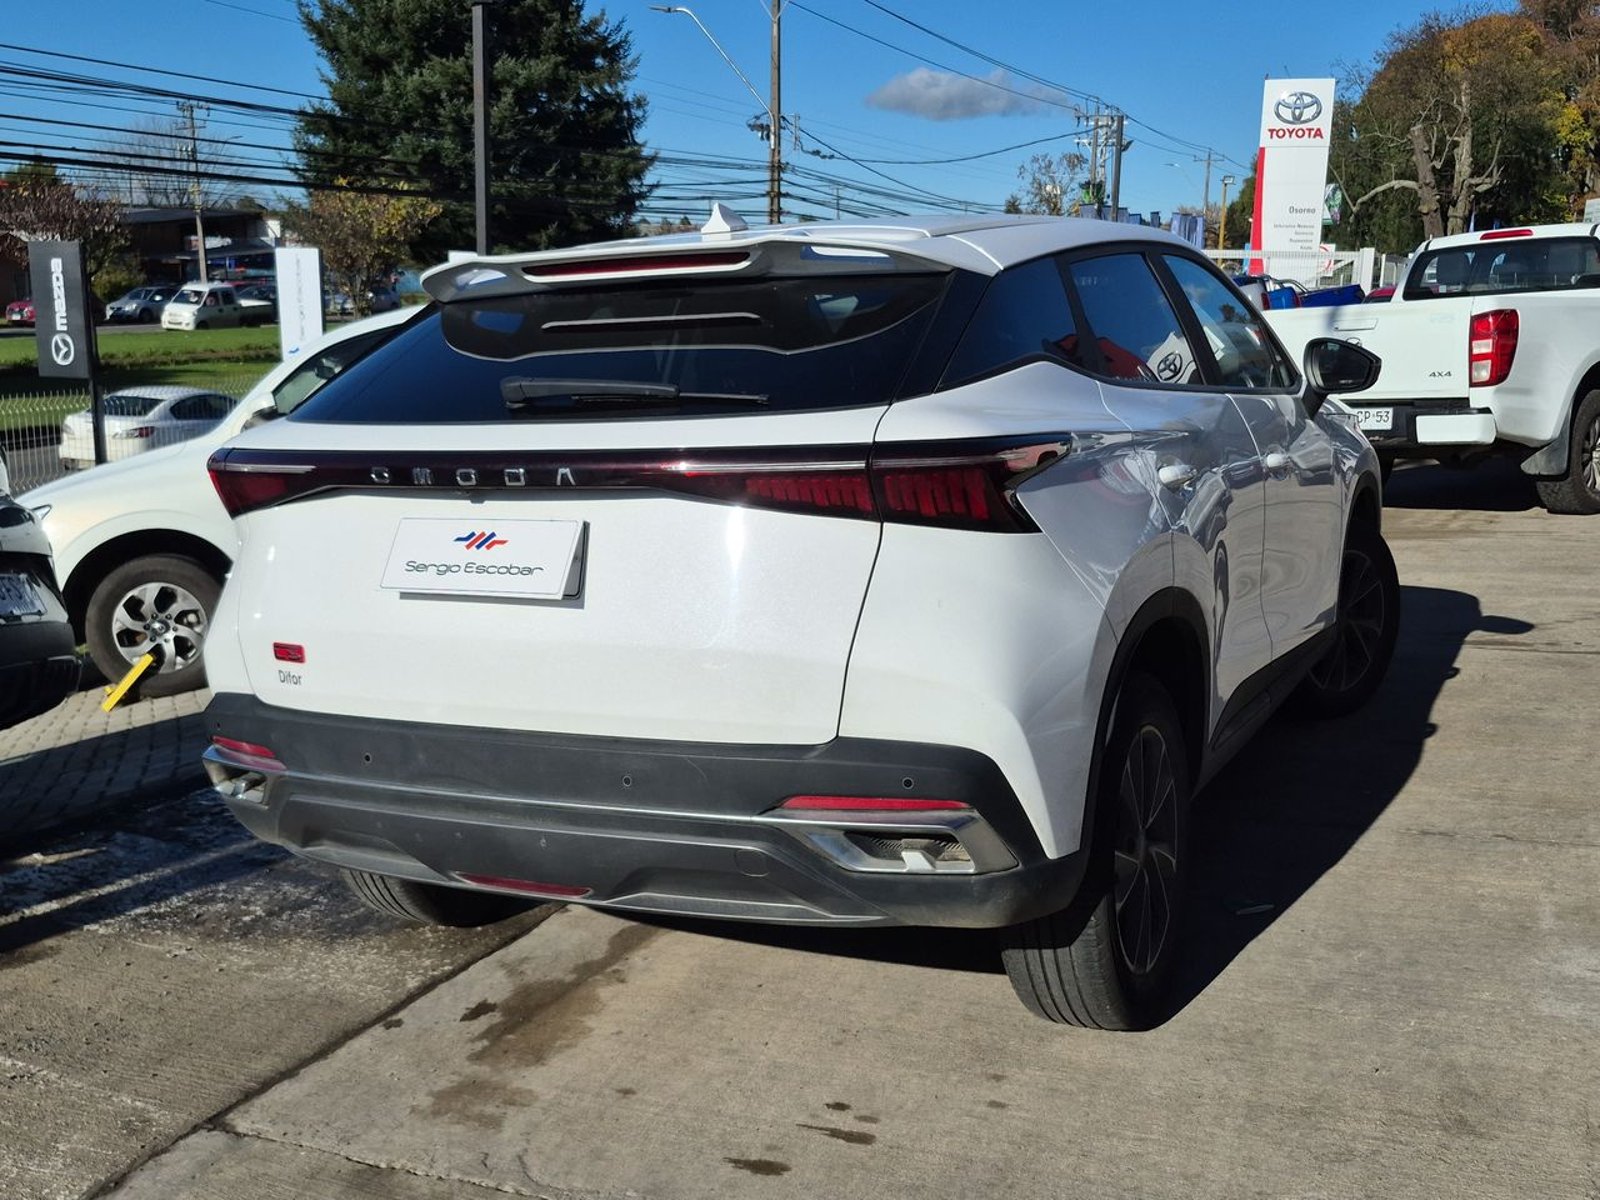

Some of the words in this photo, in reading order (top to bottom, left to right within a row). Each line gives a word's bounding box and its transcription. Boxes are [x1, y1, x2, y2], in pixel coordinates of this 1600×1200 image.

[1268, 128, 1324, 139] TOYOTA
[1288, 206, 1316, 214] Osorno
[370, 466, 576, 486] OMODA
[464, 562, 544, 576] Escobar
